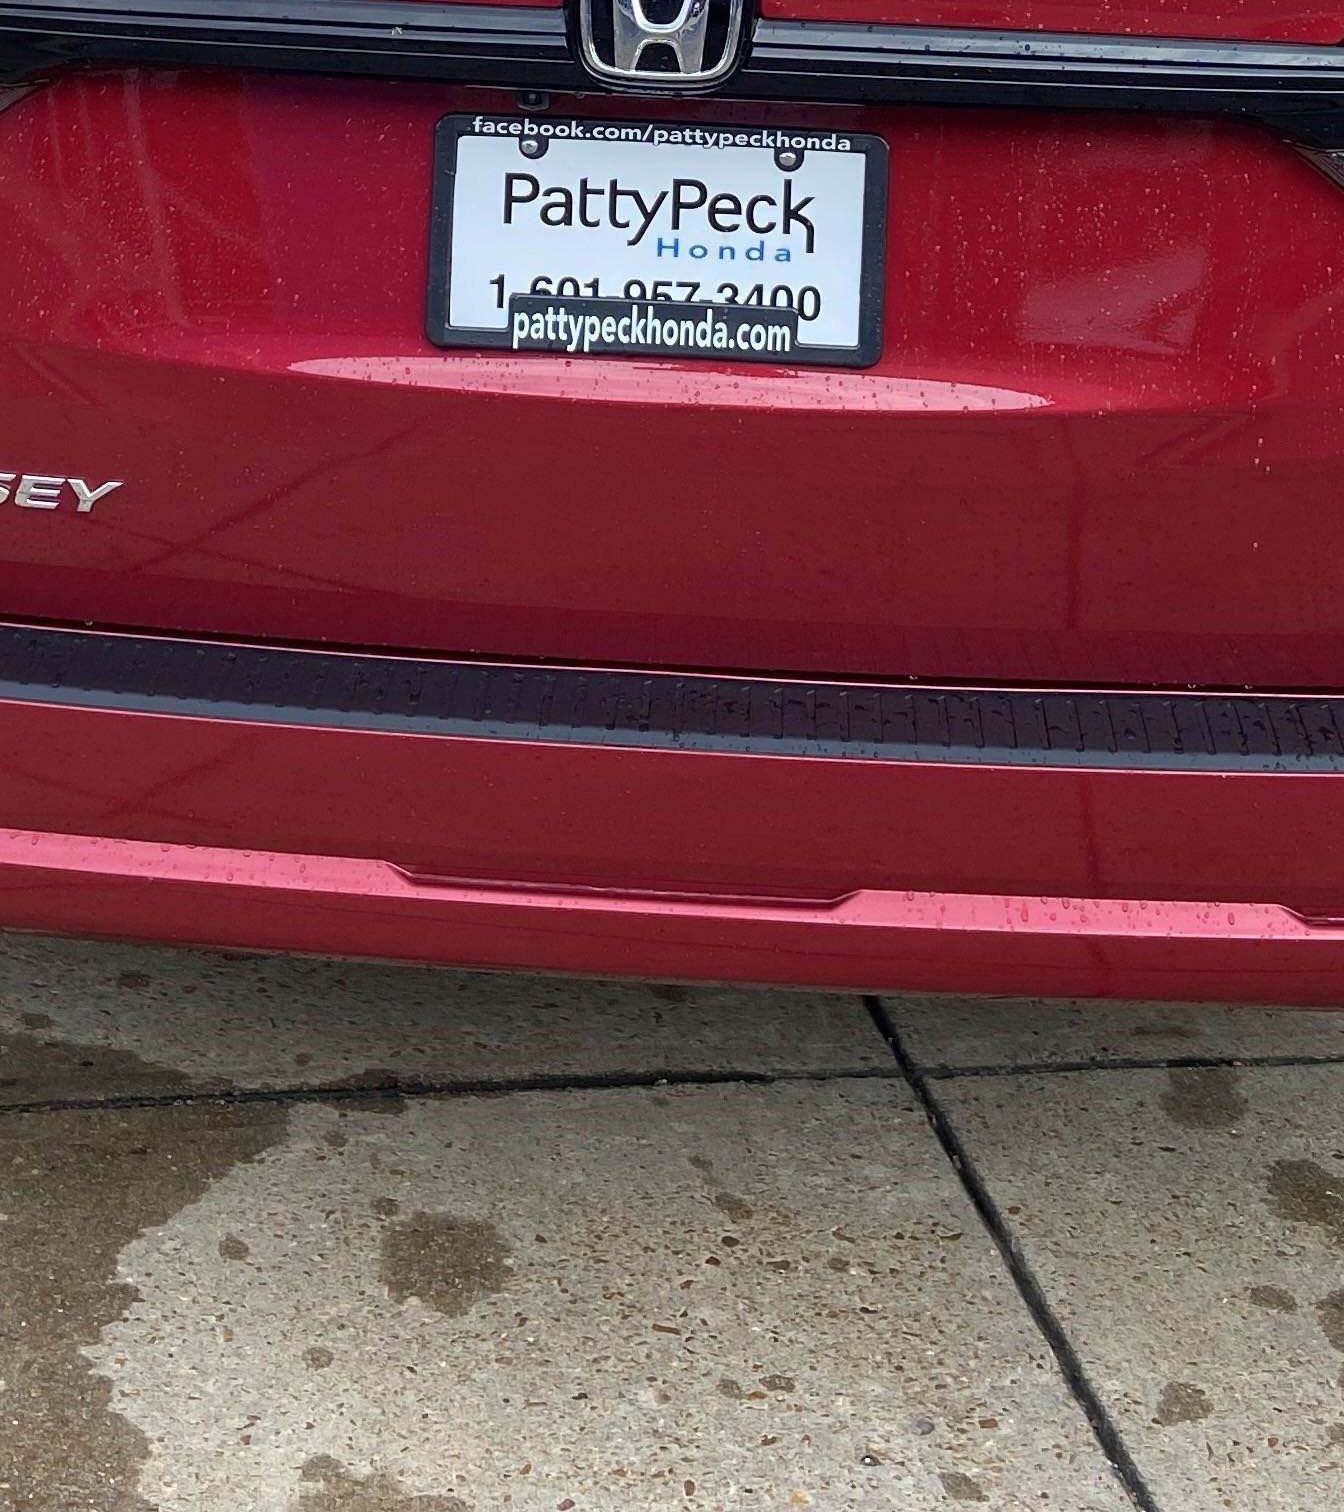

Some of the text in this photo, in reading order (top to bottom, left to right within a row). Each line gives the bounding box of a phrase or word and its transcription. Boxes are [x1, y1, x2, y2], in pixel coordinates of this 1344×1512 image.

[472, 116, 852, 152] facebook.com/pattypeckhonda
[502, 171, 816, 254] PattyPeck
[656, 237, 793, 263] Honda
[512, 303, 791, 353] pattypeckhonda.com
